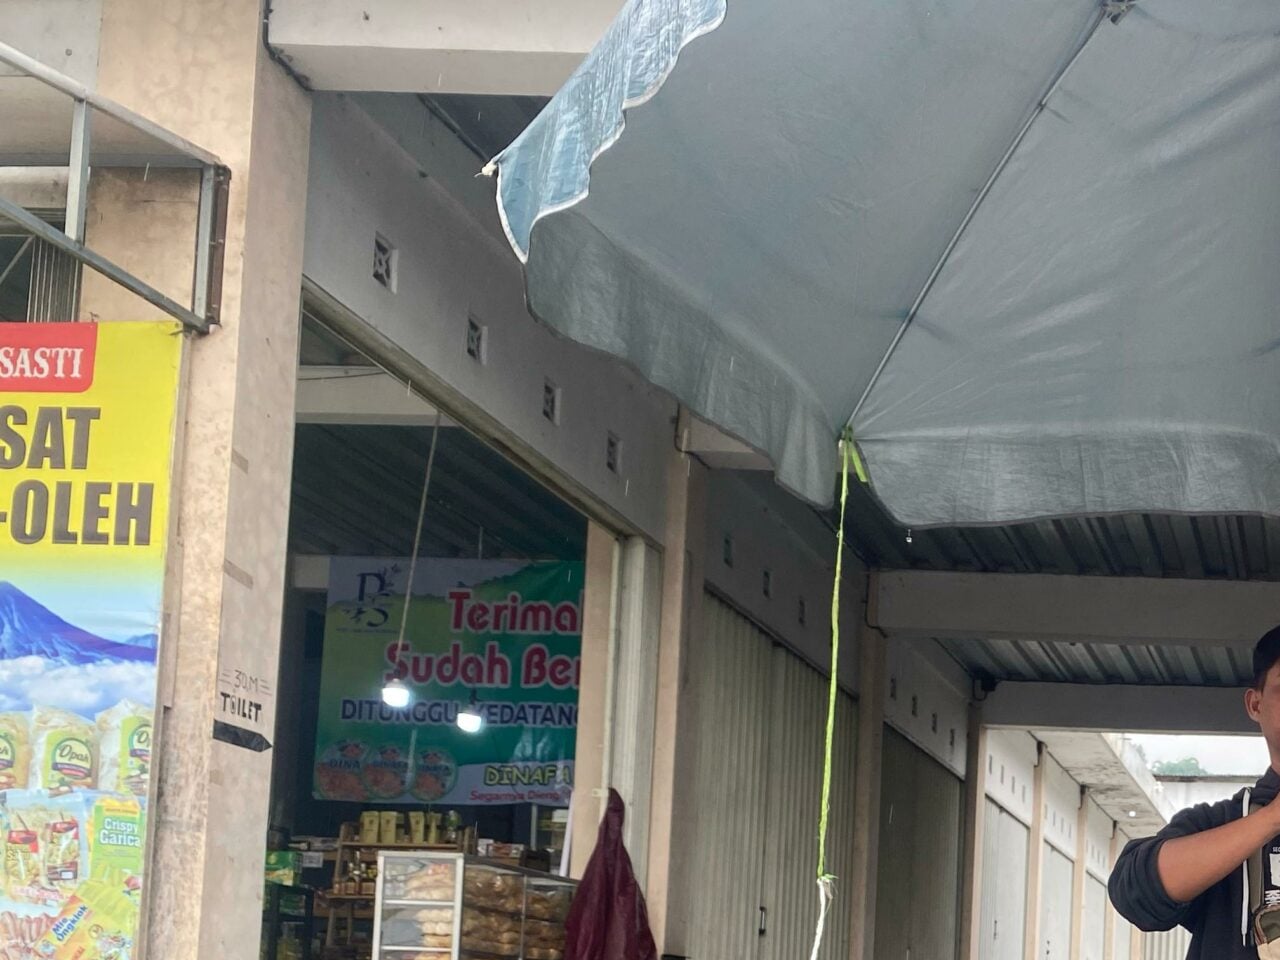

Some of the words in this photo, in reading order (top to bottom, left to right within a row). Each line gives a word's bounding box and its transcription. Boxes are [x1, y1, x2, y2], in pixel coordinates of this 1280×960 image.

[449, 591, 583, 632] Terima
[384, 642, 509, 685] Sudah
[220, 691, 262, 723] TOILET
[341, 699, 458, 723] DITUNGGU
[104, 817, 138, 834] Crispy
